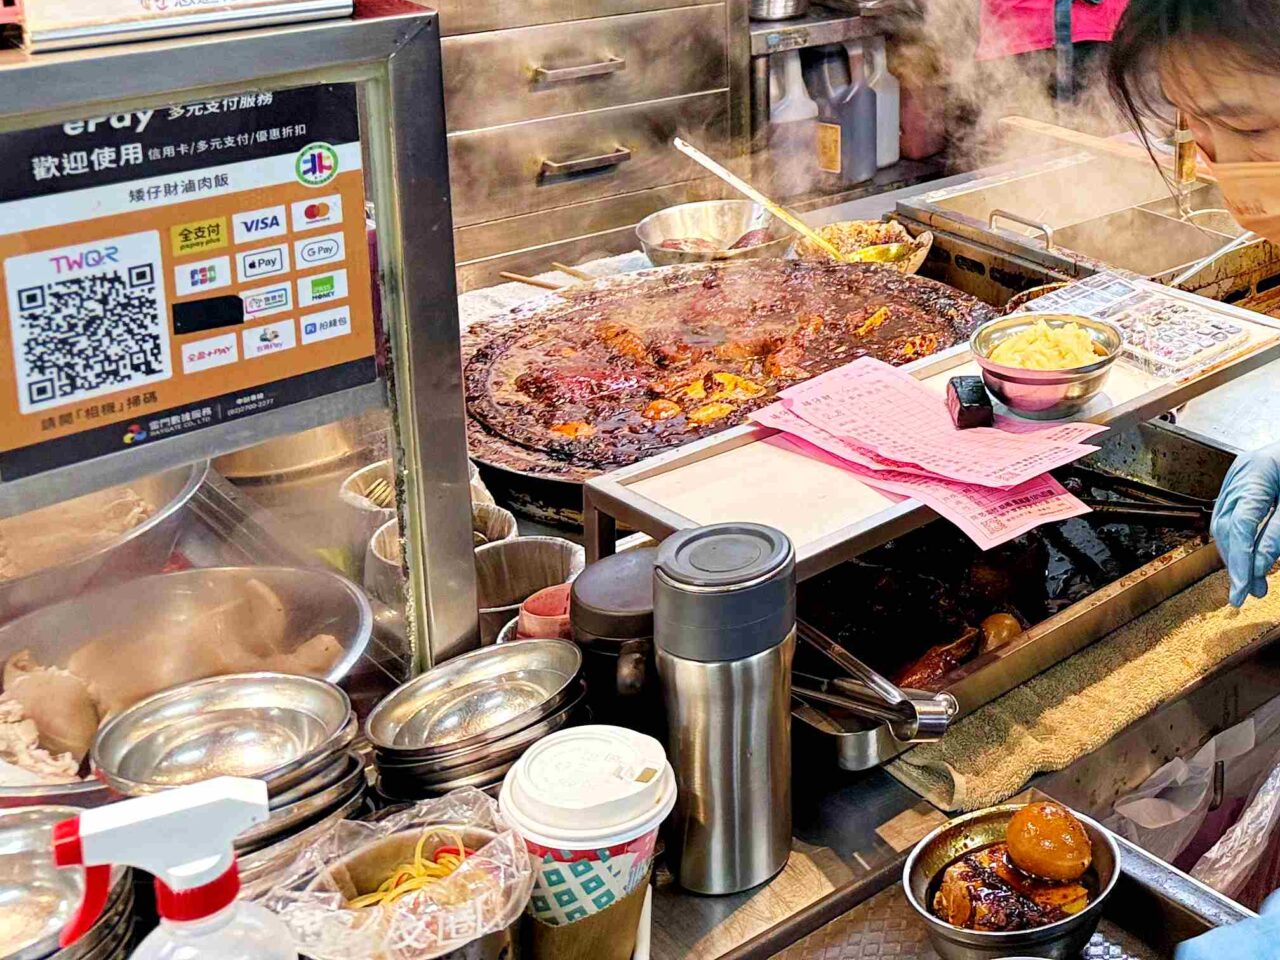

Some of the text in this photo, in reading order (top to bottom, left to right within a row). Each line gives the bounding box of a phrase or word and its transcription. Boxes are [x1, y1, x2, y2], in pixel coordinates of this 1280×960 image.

[31, 142, 144, 182] 歡迎使用
[129, 173, 230, 203] 矮仔財滷肉飯
[179, 223, 221, 242] 全支付
[241, 215, 280, 233] VISA
[50, 246, 119, 273] TWQR
[257, 256, 278, 268] Pay
